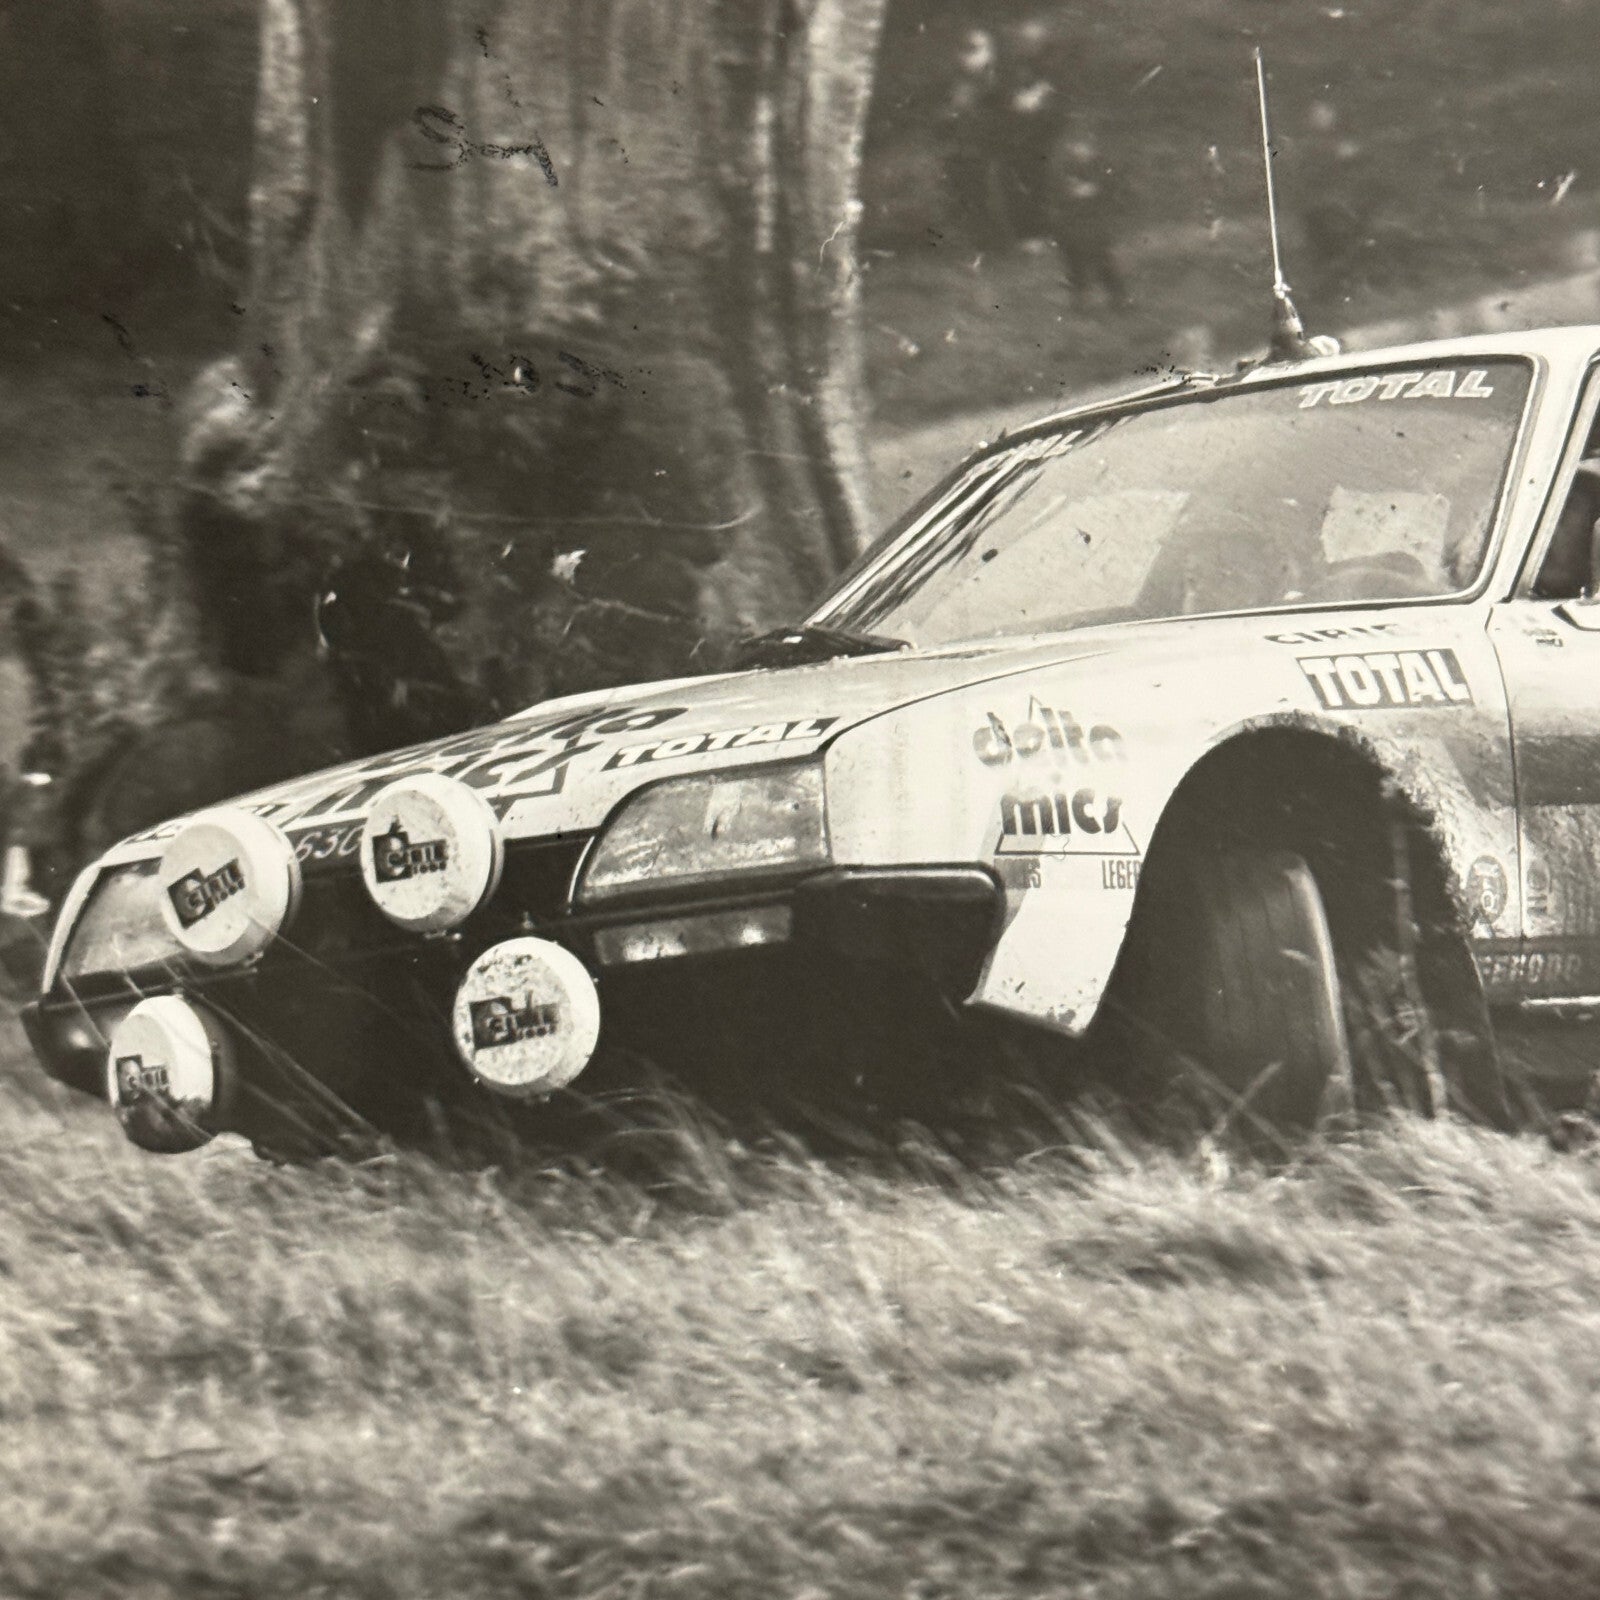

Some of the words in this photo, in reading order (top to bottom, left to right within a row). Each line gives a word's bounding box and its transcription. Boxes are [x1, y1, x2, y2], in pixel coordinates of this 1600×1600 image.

[1299, 370, 1494, 409] TOTAL
[1300, 650, 1470, 707] TOTAL
[616, 718, 823, 768] TOTAL
